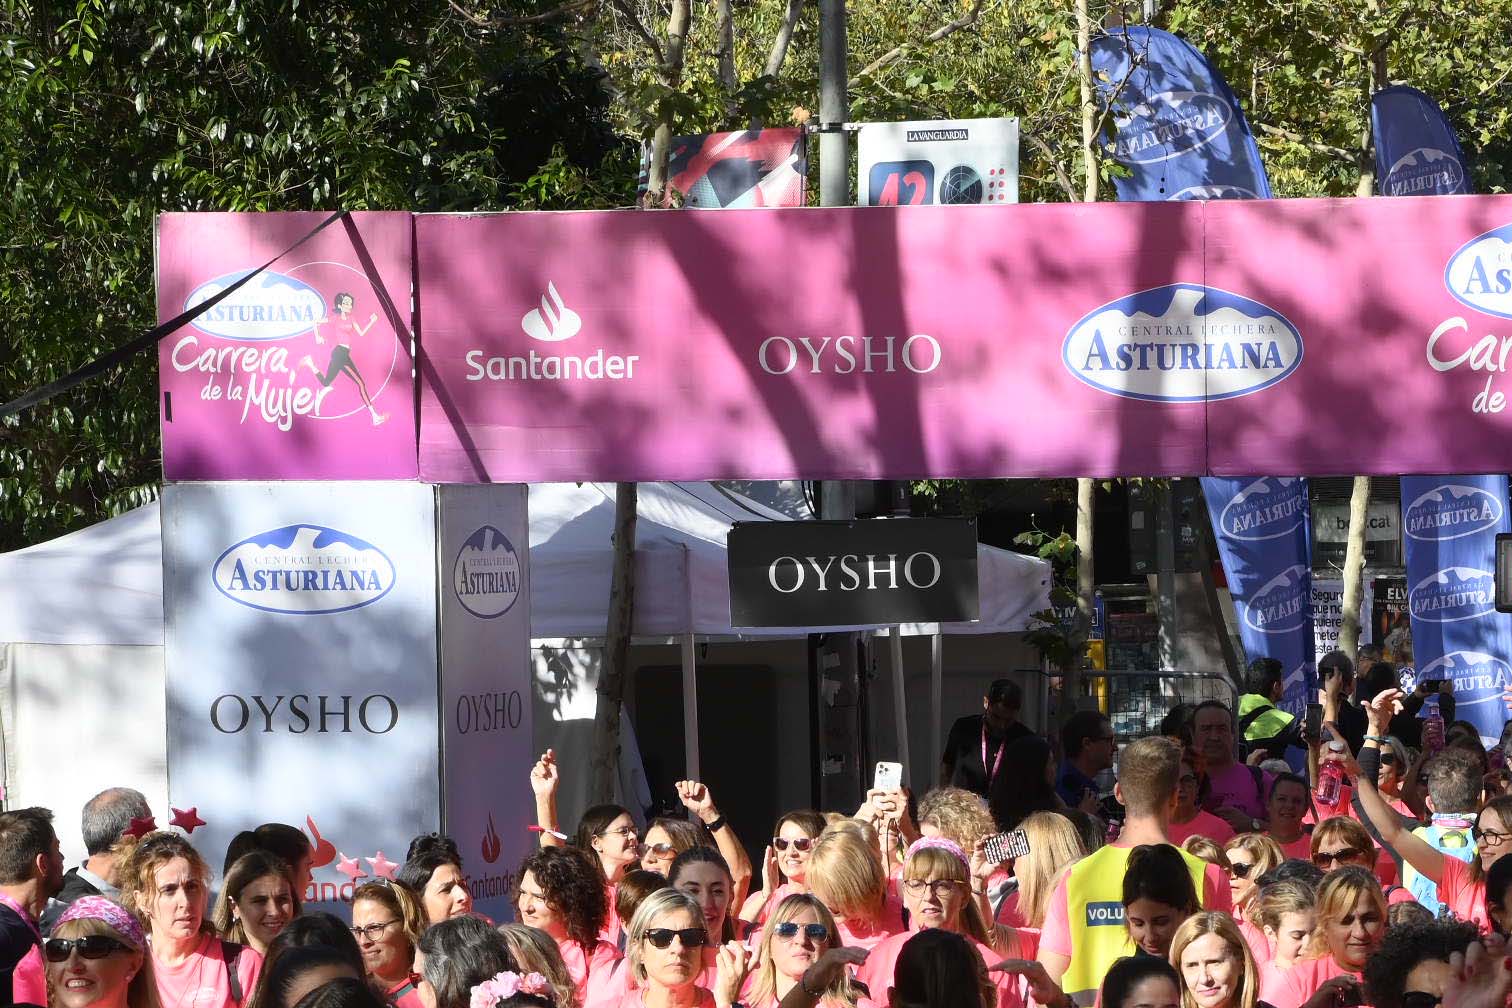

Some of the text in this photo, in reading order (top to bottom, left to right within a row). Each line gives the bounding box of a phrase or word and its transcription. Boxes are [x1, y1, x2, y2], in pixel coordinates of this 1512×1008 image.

[918, 130, 968, 141] VANGUARDIA
[1118, 324, 1193, 337] CENTRAL
[171, 335, 290, 373] Carrera
[465, 350, 640, 381] Santander
[758, 334, 943, 375] OYSHO
[1082, 328, 1285, 372] ASTURIANA
[200, 370, 335, 432] de la Mujer
[1471, 375, 1506, 414] de
[228, 557, 383, 592] ASTURIANA
[318, 555, 369, 565] LECHER
[459, 560, 517, 596] ASTURIANA
[768, 551, 941, 593] OYSHO
[210, 693, 399, 735] OYSHO
[456, 689, 522, 735] OYSHO
[466, 869, 516, 899] Santande
[1087, 907, 1124, 921] VOLU
